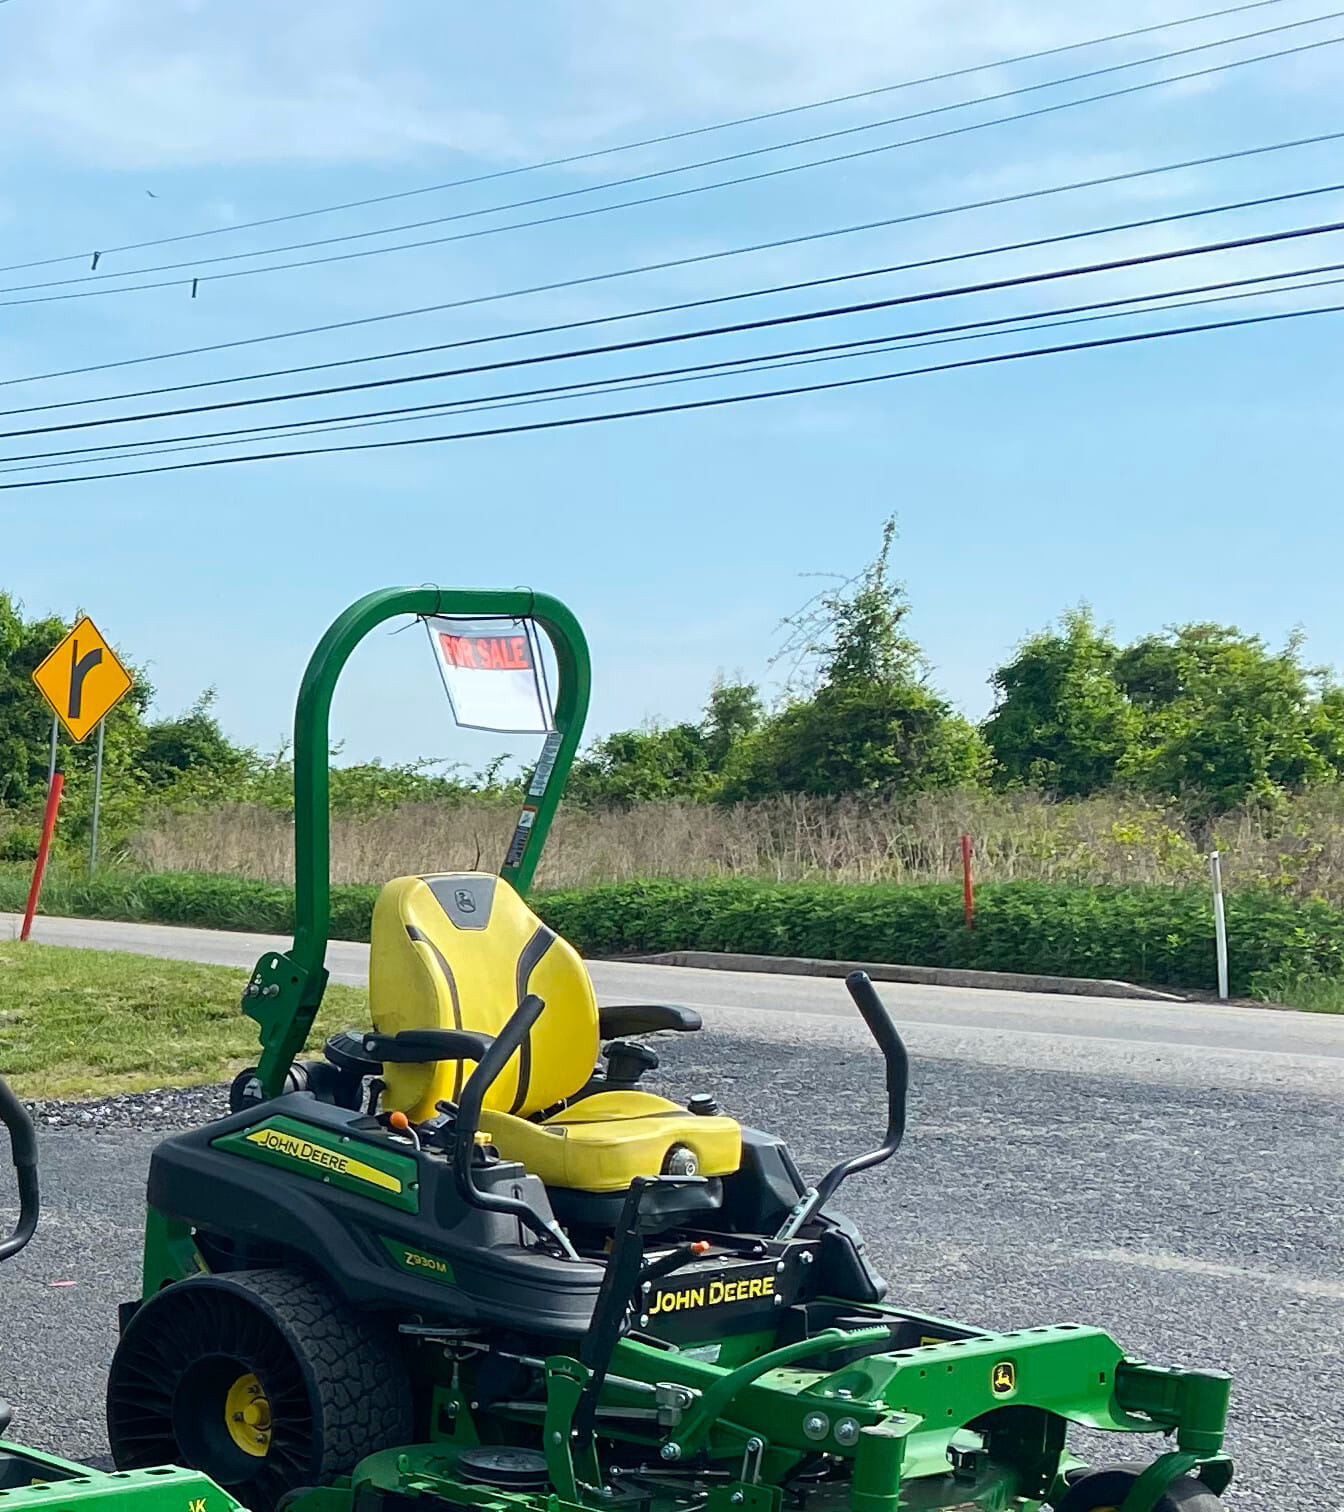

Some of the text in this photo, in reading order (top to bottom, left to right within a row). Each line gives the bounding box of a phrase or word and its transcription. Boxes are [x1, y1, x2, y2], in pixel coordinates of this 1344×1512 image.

[477, 637, 529, 669] SALE
[260, 1131, 349, 1171] JOHN DEERE
[648, 1276, 776, 1315] JOHN DEERE
